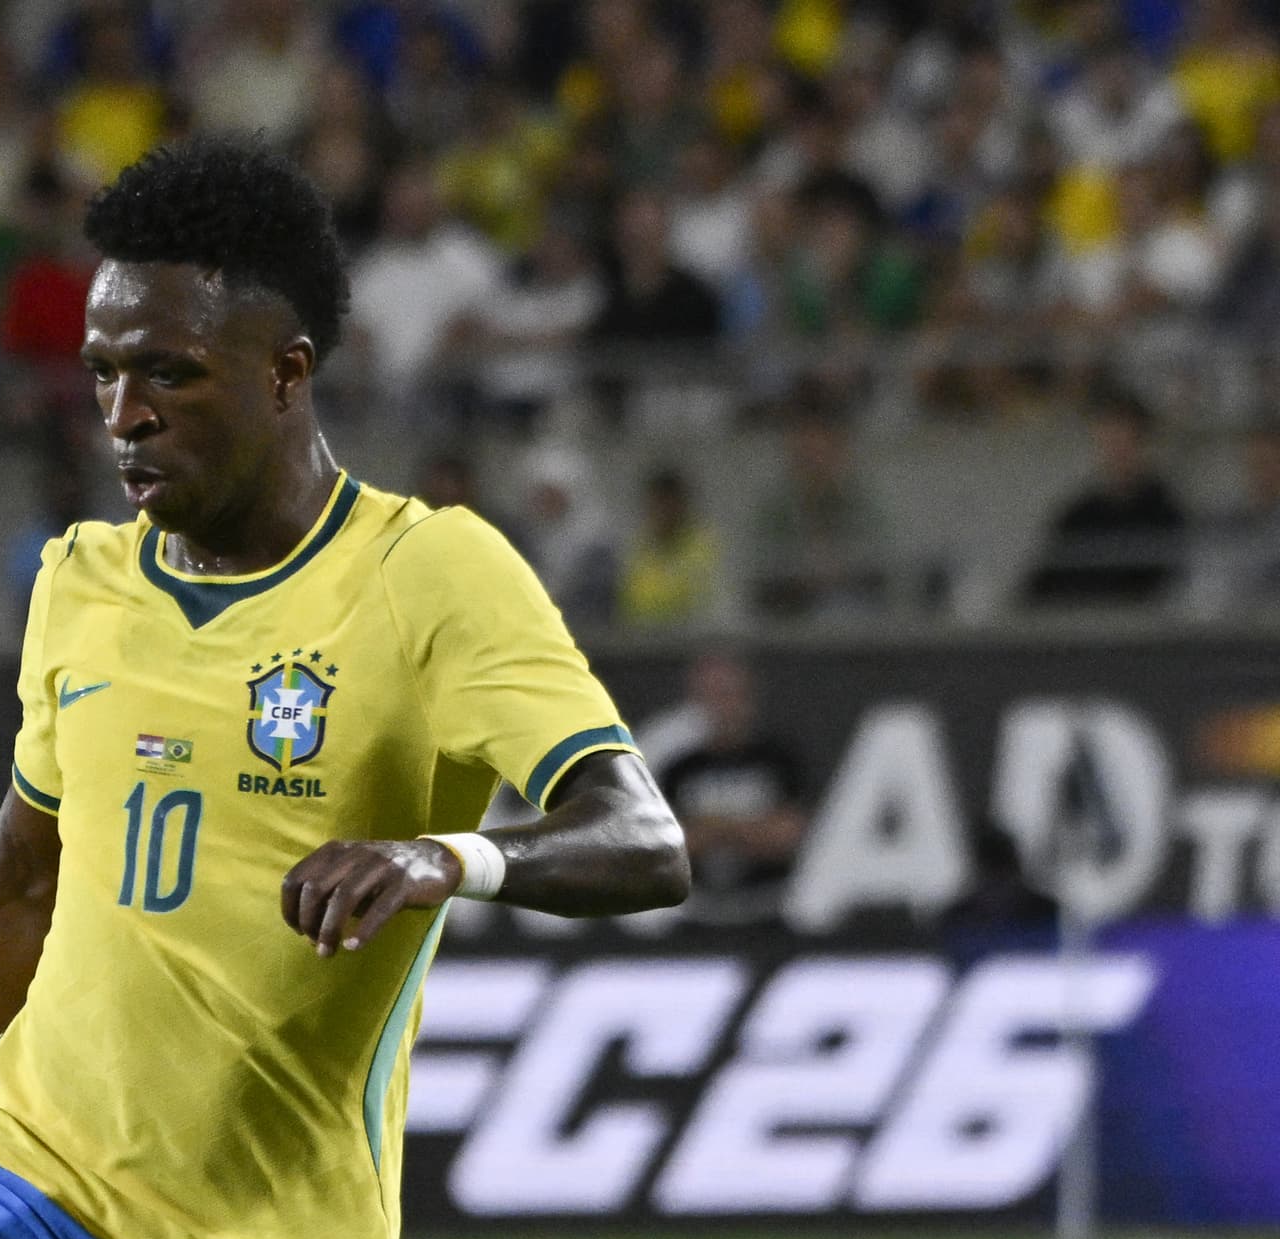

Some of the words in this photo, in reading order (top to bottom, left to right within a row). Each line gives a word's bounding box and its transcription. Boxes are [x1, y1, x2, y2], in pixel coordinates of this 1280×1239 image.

[270, 705, 303, 721] CBF
[237, 772, 327, 799] BRASIL
[117, 780, 204, 914] 10
[1181, 788, 1280, 928] T
